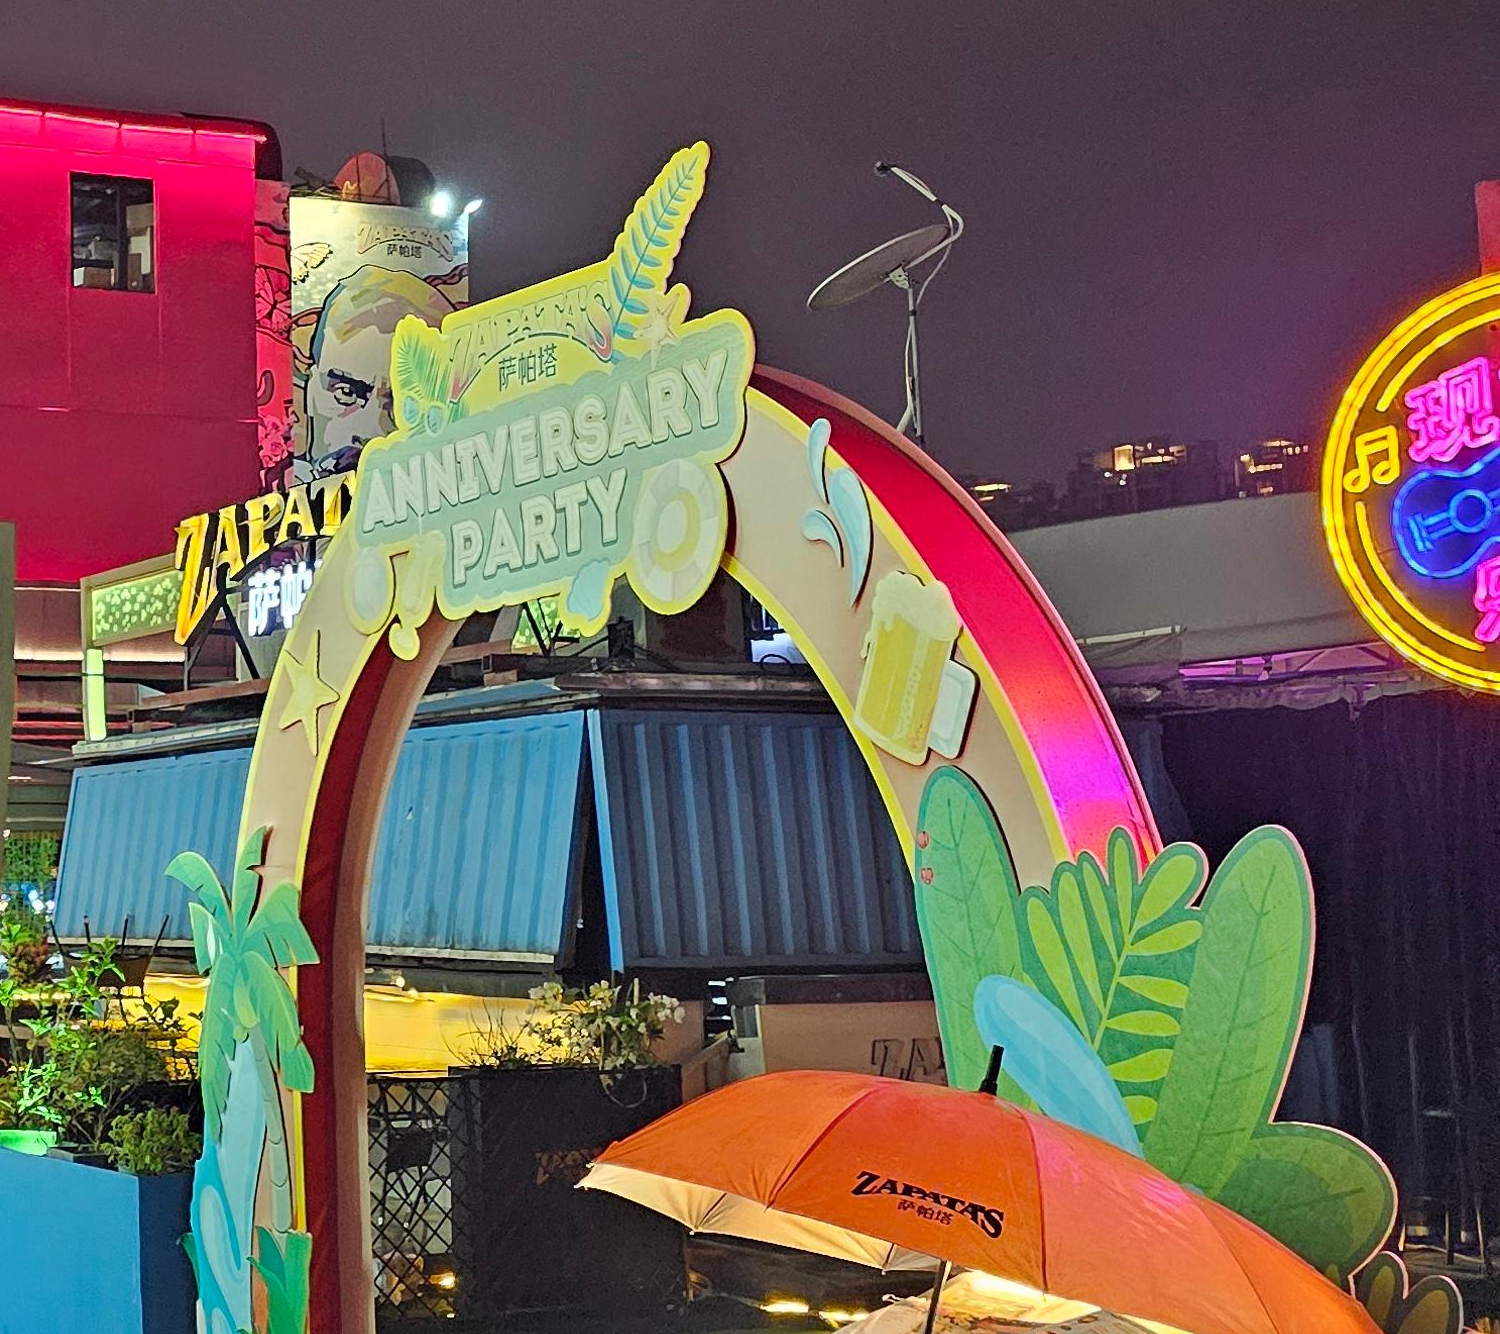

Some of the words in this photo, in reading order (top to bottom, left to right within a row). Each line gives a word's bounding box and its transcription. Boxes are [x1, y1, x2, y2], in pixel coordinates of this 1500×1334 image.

[386, 243, 422, 259] 萨帕塔
[498, 342, 558, 392] 萨帕塔
[363, 348, 727, 534] ANNIVERSARY
[1404, 355, 1500, 463] 现
[451, 467, 628, 588] PARTY
[897, 1199, 953, 1225] 萨帕塔
